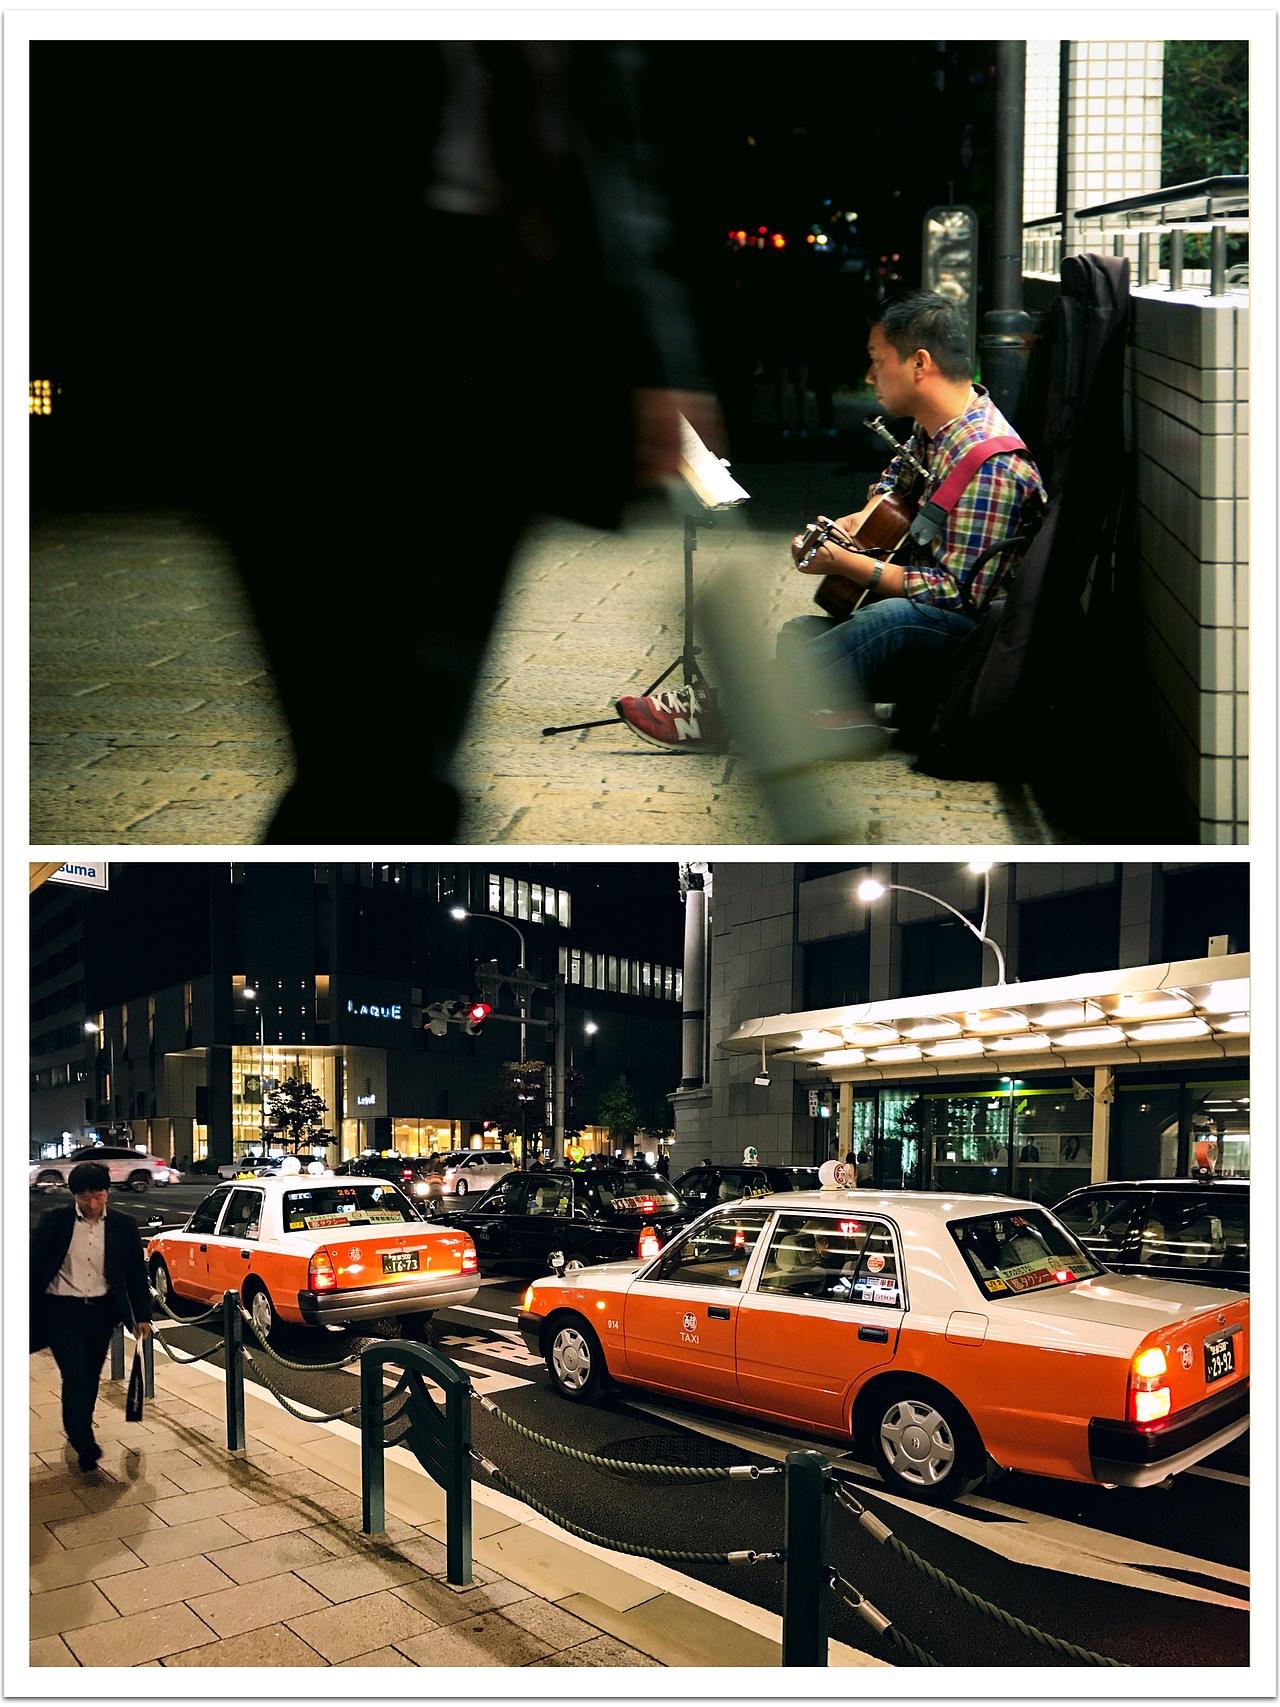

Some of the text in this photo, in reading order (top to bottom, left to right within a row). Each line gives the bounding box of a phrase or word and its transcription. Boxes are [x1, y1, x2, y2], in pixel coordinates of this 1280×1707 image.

[673, 717, 701, 741] N
[291, 1193, 310, 1201] ETC
[607, 1320, 619, 1329] 914
[680, 1332, 700, 1344] TAXI
[1211, 1351, 1233, 1377] 29-92
